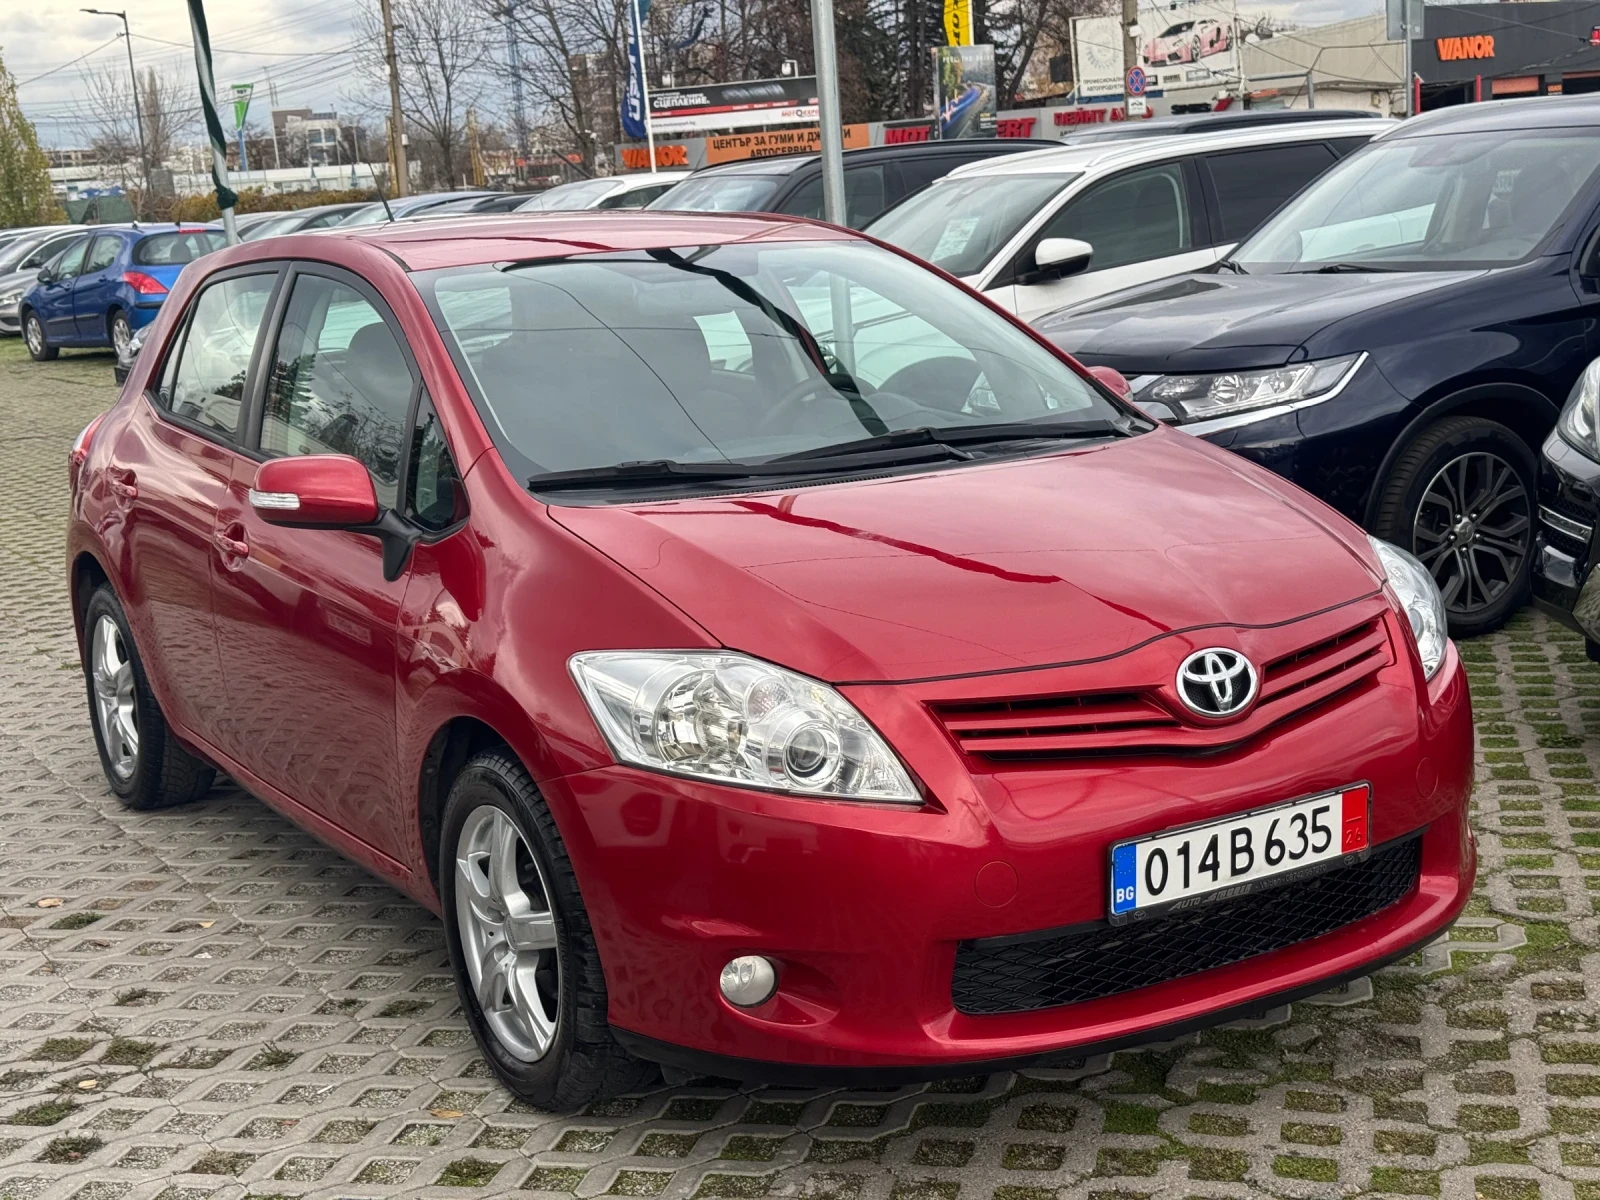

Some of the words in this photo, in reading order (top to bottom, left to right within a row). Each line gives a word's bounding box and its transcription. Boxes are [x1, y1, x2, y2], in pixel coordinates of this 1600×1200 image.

[712, 136, 751, 150] ЦЕНТЪР
[754, 135, 766, 147] ЗА
[768, 133, 794, 145] ГУМИ
[797, 132, 805, 142] И
[1116, 886, 1135, 904] BG
